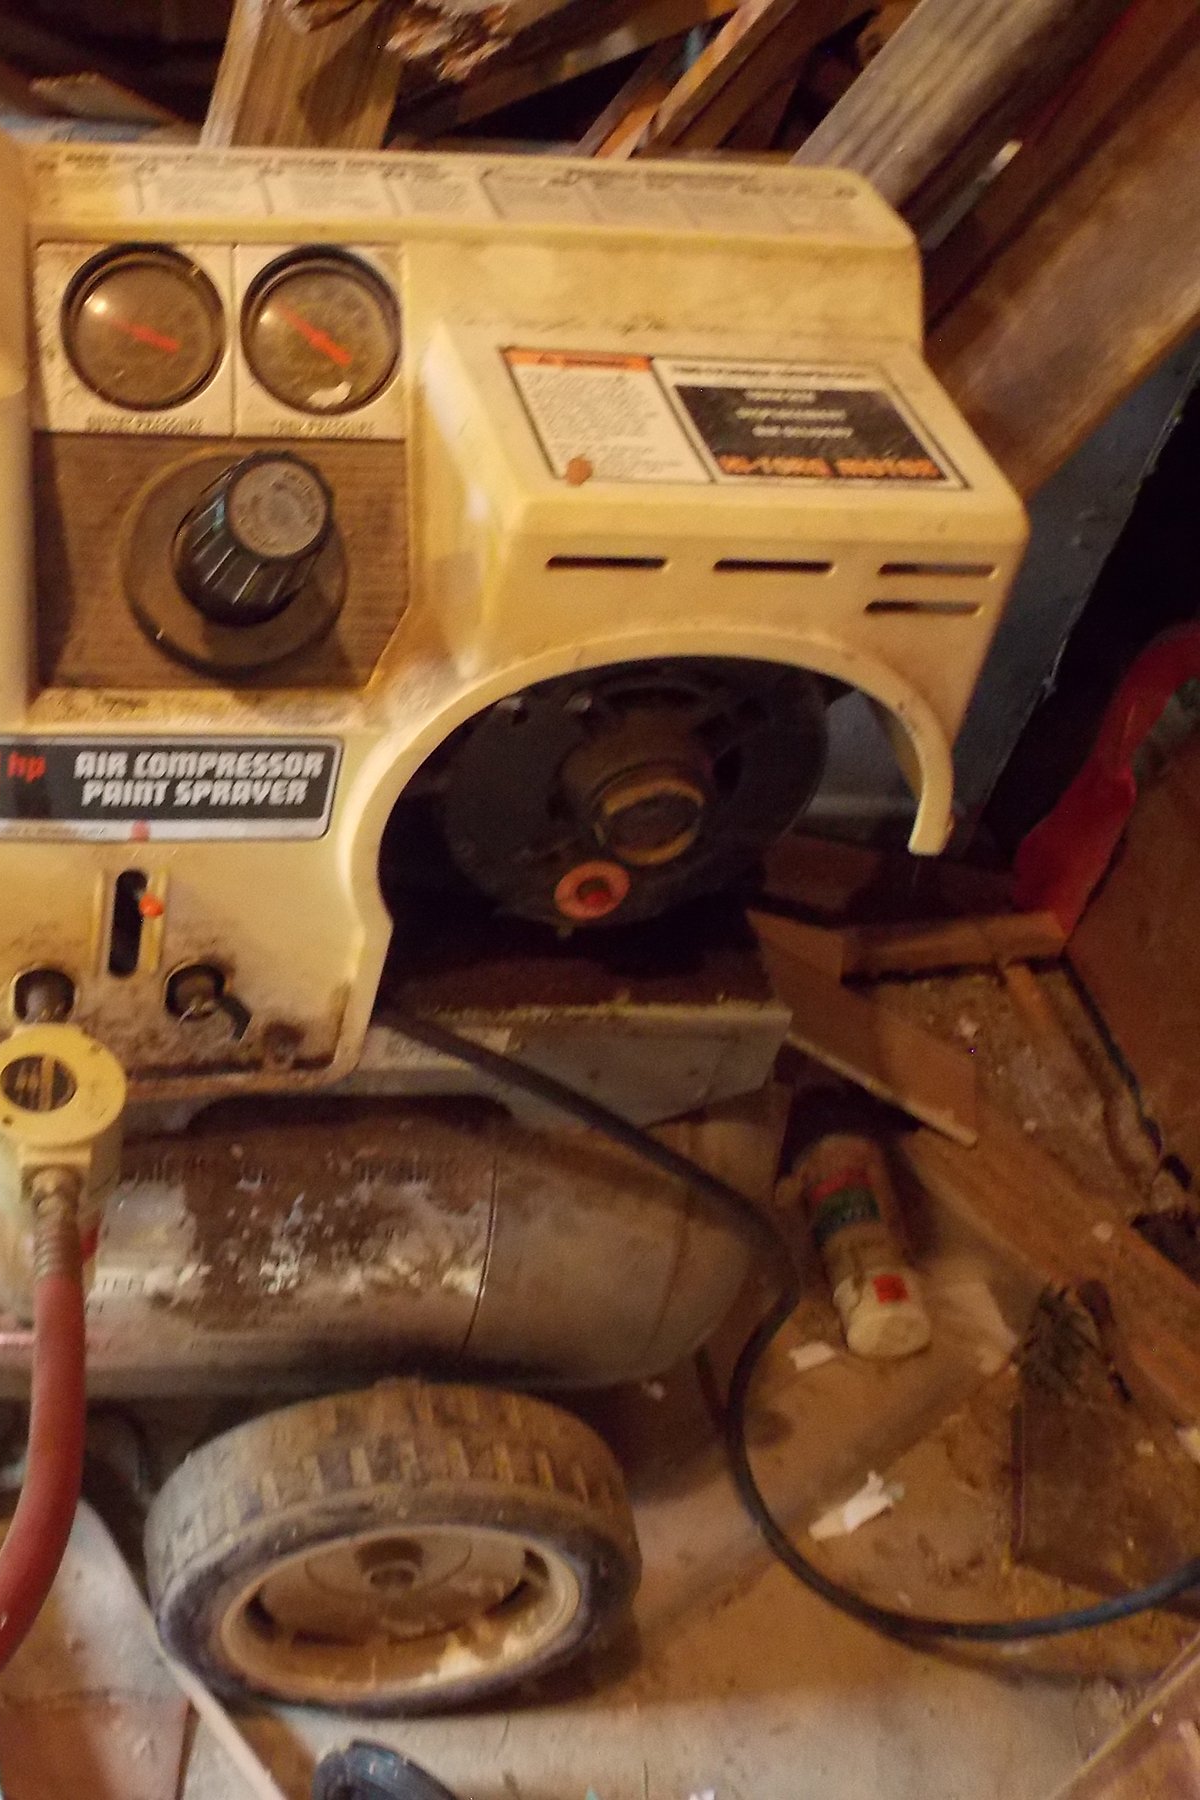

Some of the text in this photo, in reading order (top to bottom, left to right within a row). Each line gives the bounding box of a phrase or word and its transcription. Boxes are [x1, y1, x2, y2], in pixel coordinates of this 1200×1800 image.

[6, 752, 46, 783] hp
[73, 751, 324, 780] AIR COMPRESSOR
[81, 779, 308, 807] PAINT SPRAYER
